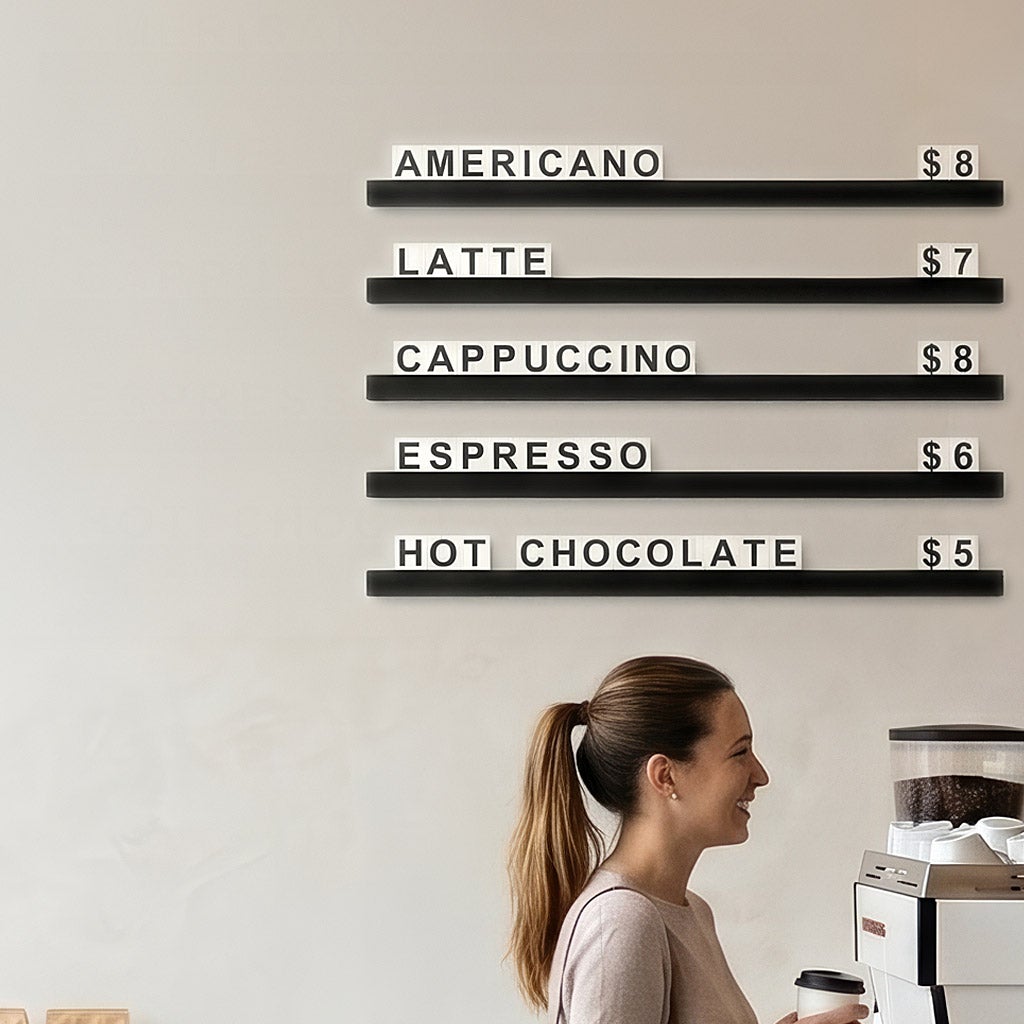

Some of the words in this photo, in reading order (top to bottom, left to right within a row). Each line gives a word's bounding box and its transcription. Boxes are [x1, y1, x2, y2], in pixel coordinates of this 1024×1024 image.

[394, 149, 659, 177] AMERICANO
[399, 247, 546, 275] LATTE
[397, 344, 691, 373] CAPPUCCINO
[399, 441, 647, 470] ESPRESSO
[399, 539, 486, 567] HOT
[520, 539, 797, 567] CHOCOLATE
